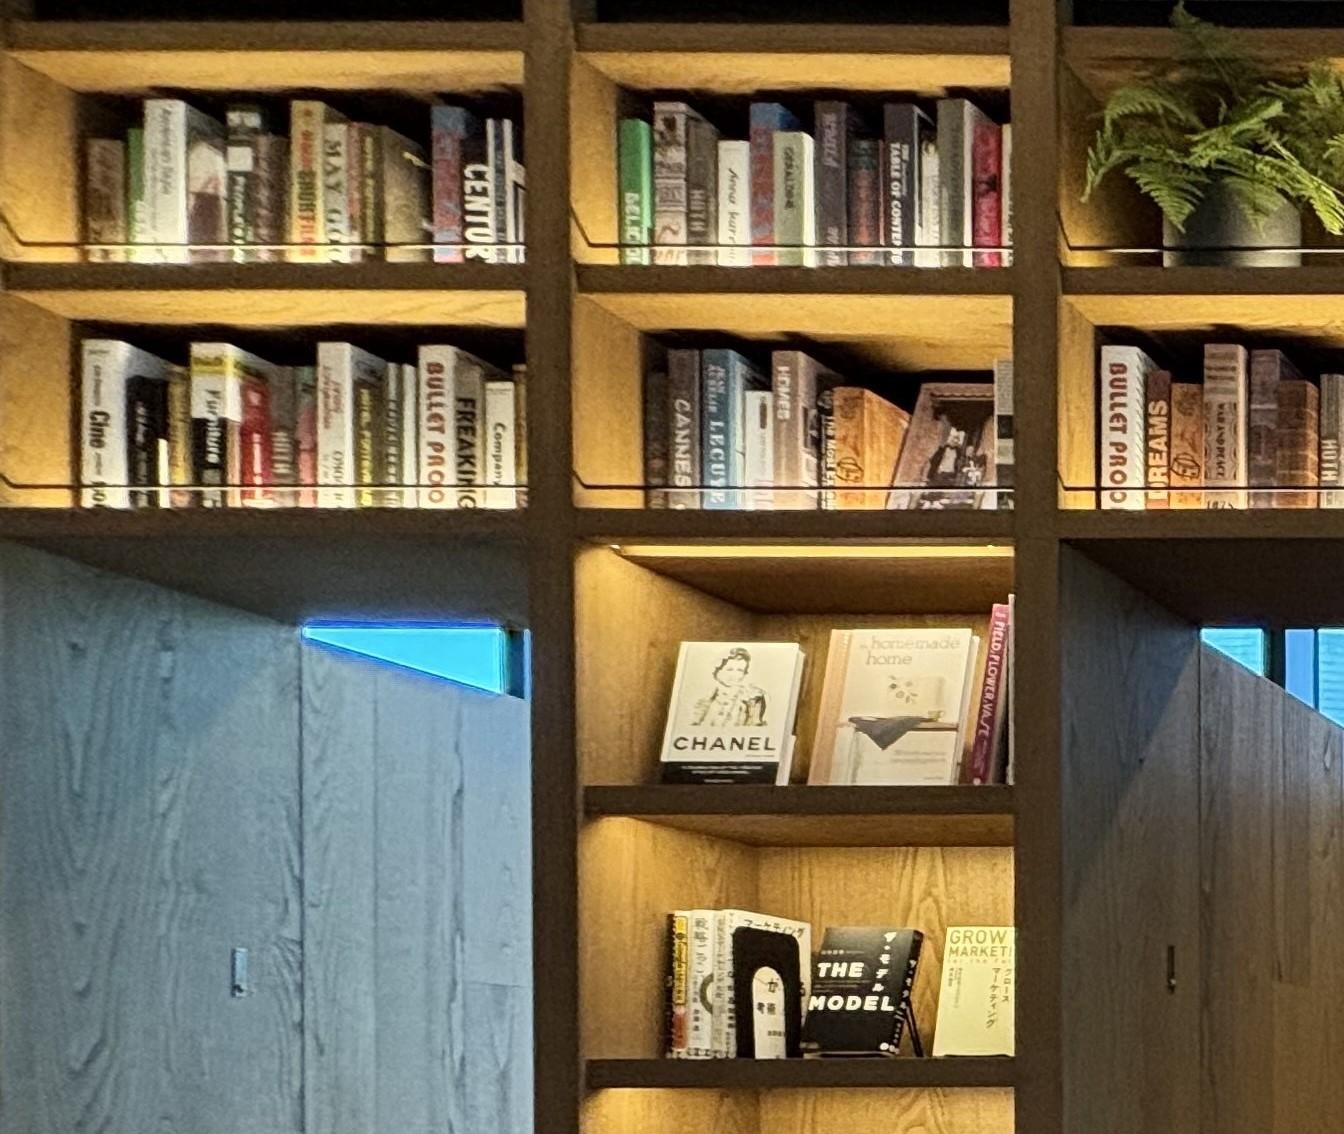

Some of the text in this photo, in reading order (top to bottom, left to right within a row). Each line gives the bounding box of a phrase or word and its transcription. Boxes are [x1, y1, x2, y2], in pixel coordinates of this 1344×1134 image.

[426, 362, 445, 434] BULLET
[1109, 362, 1128, 435] BULLET
[865, 650, 913, 667] home
[672, 736, 776, 752] CHANEL
[816, 961, 866, 979] THE
[808, 995, 896, 1013] MODEL
